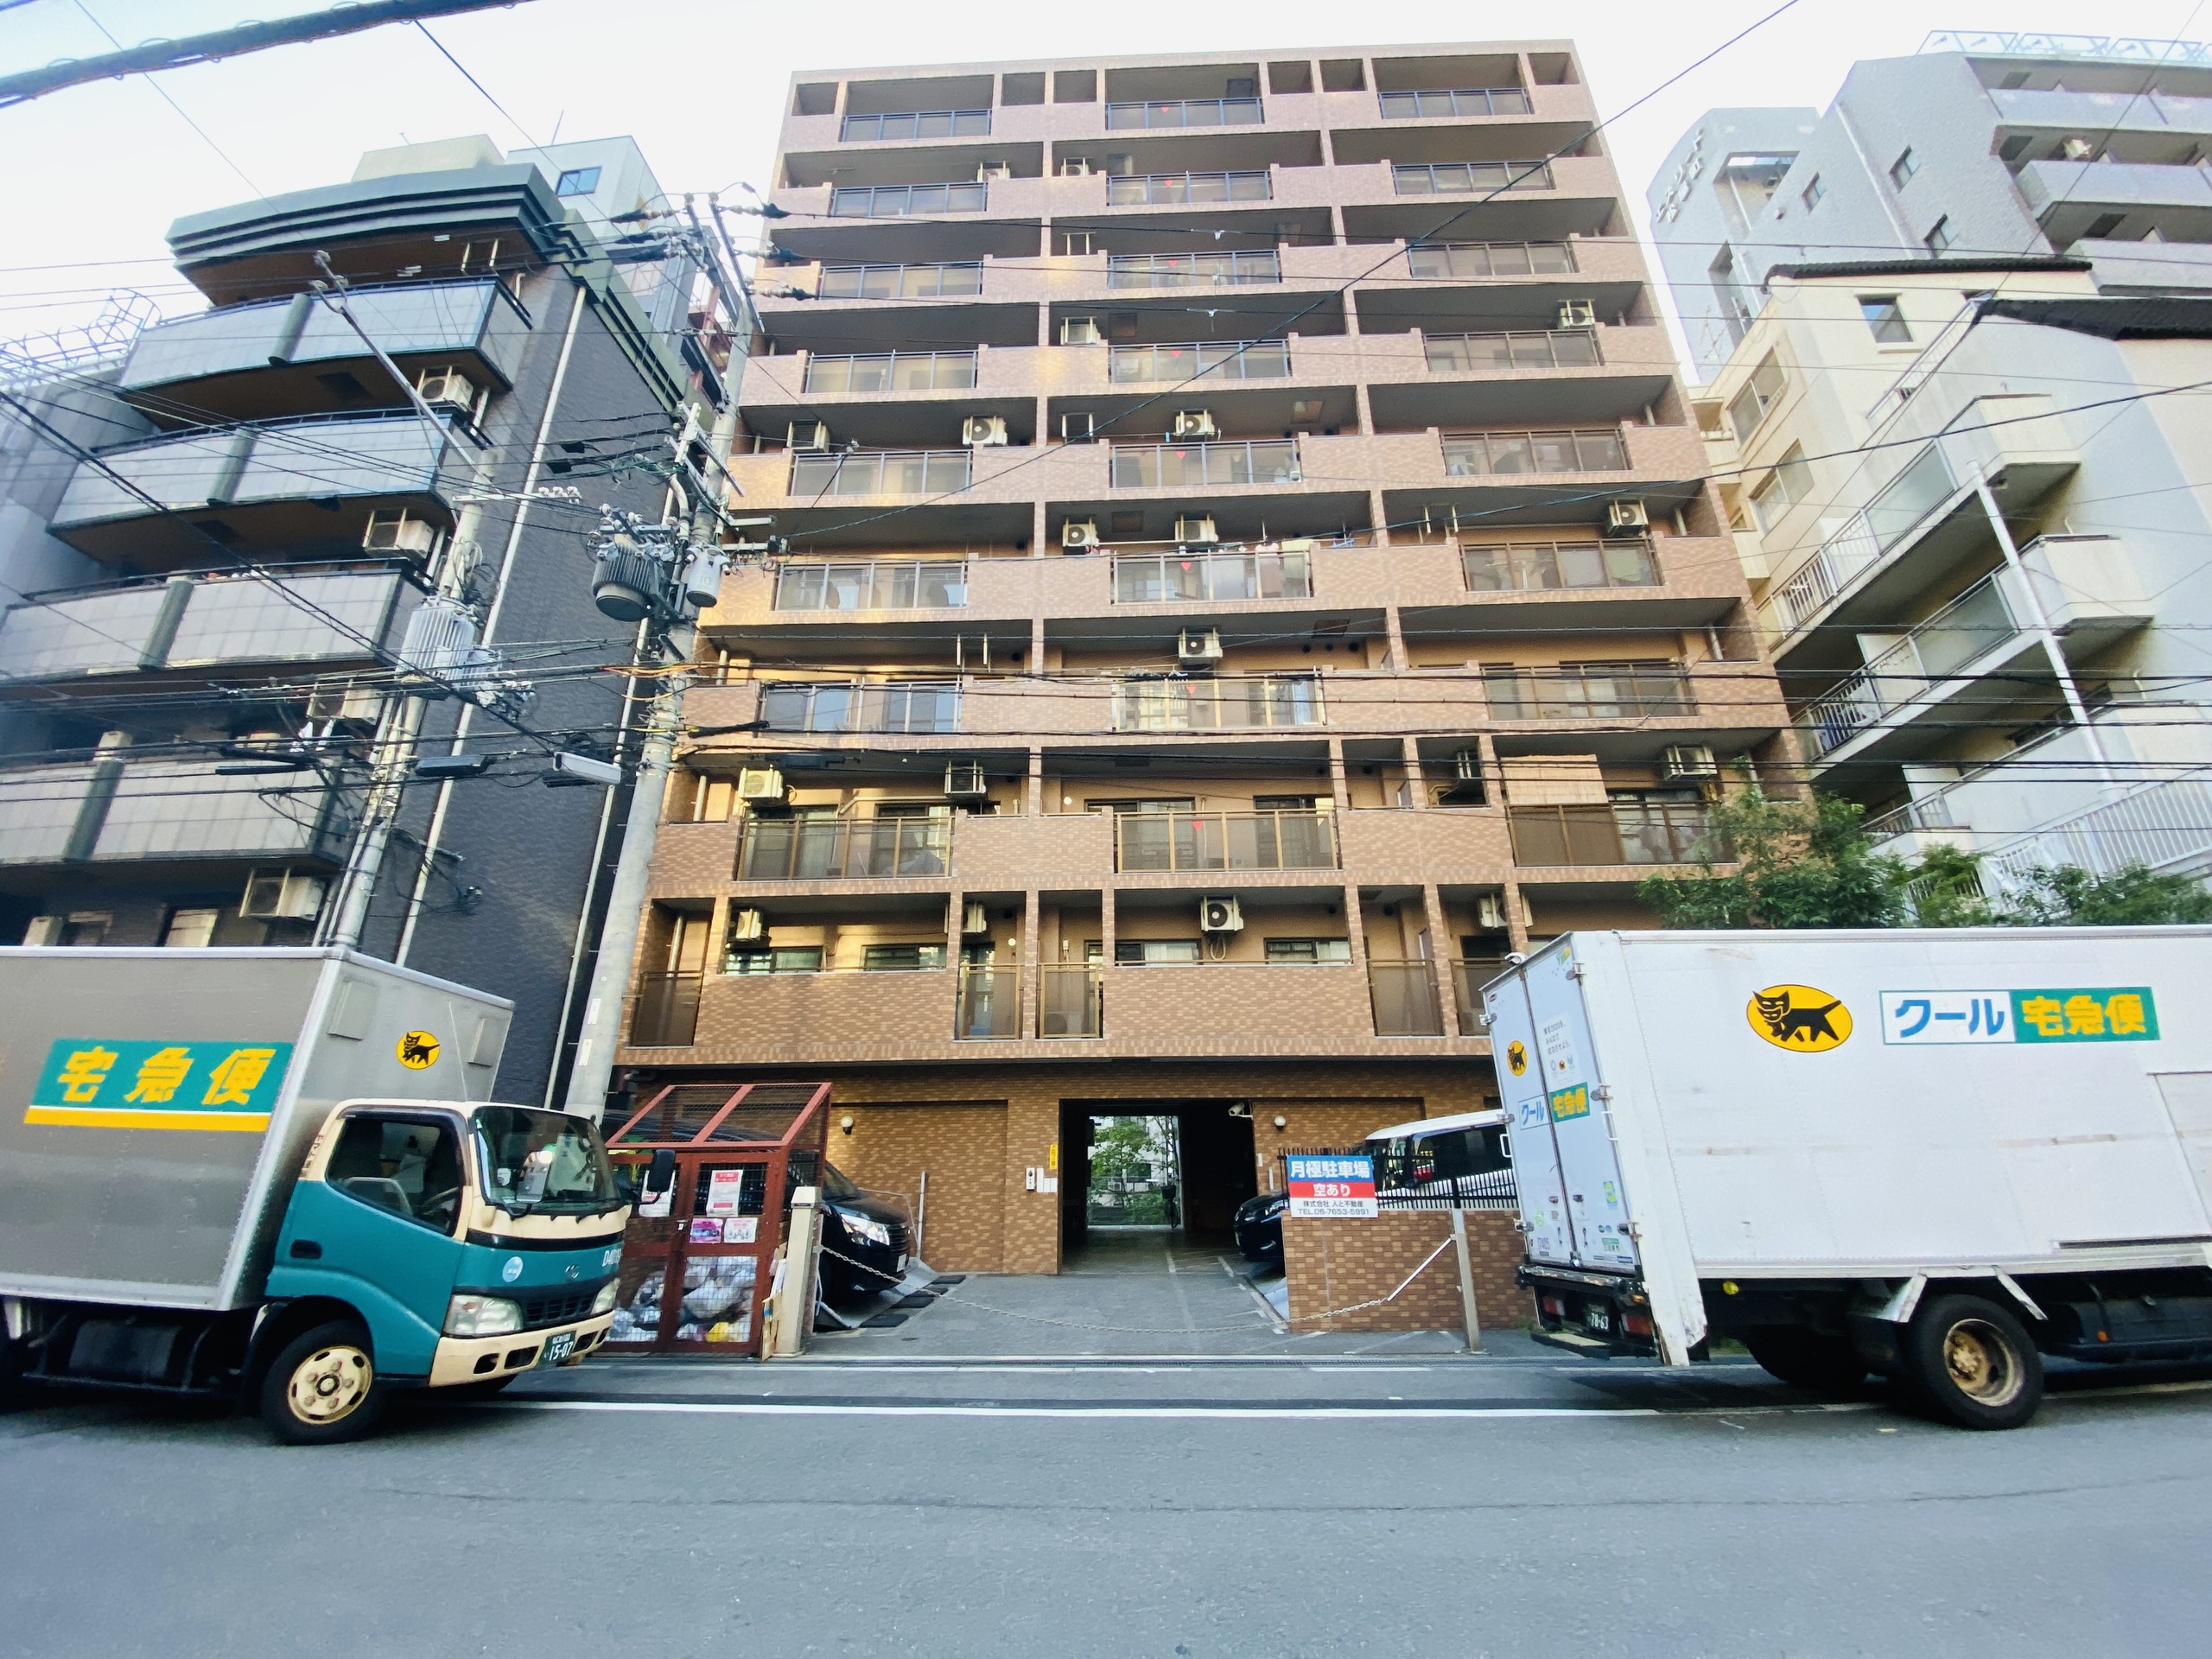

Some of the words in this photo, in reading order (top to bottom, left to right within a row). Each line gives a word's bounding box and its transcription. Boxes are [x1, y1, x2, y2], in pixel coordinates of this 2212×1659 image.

[1895, 998, 2005, 1039] クール
[2020, 994, 2147, 1037] 宅急便
[57, 1045, 276, 1105] 宅急便
[1521, 1100, 1545, 1126] クール
[1552, 1087, 1587, 1118] 宅急便
[1291, 1160, 1370, 1179] 月極駐車場
[1313, 1183, 1351, 1197] 空あり
[1591, 1313, 1609, 1330] 78-63
[549, 1342, 574, 1362] 15-07
